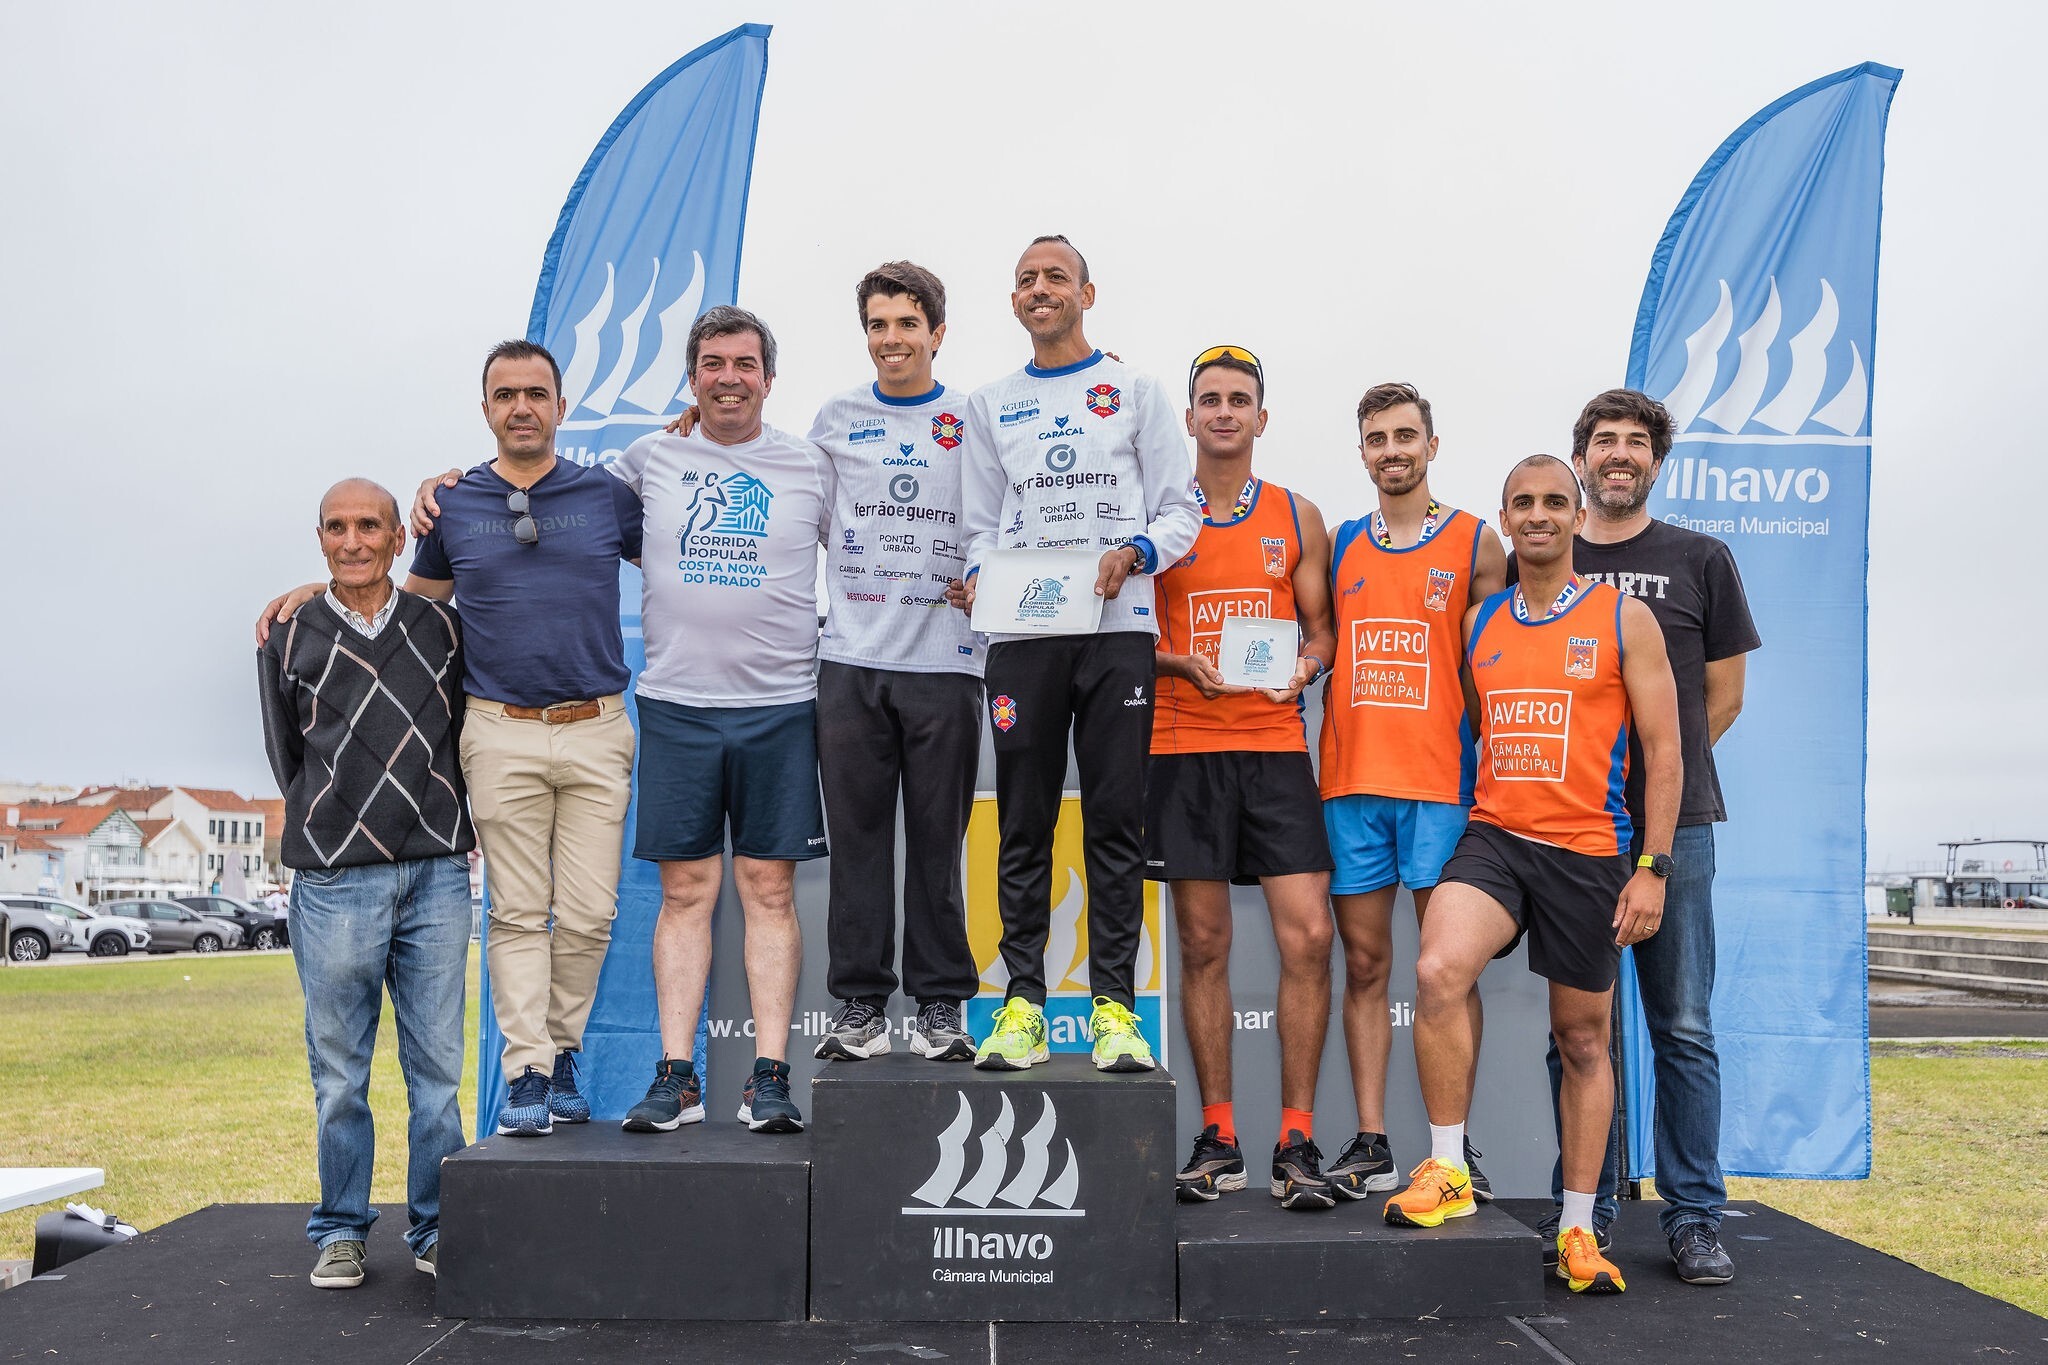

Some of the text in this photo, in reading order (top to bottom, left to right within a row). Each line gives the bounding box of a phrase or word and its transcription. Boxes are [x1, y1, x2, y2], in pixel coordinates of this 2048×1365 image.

[1038, 427, 1085, 440] CARACAL
[882, 458, 930, 468] CARACAL
[1666, 457, 1830, 504] Ilhavo
[1040, 502, 1076, 514] PONTO
[1044, 512, 1086, 523] URBANO
[1740, 517, 1830, 538] Municipal
[690, 535, 758, 549] CORRIDA
[880, 534, 914, 545] PONTO
[1037, 537, 1090, 549] colorcenter
[1262, 538, 1285, 546] CENAP
[688, 548, 758, 562] POPULAR
[882, 544, 922, 554] URBANO
[678, 560, 768, 576] COSTA NOVA
[1430, 568, 1455, 580] CENAP
[684, 573, 761, 588] DO PRADO
[873, 570, 923, 580] colorcenter
[932, 574, 957, 584] ITALB
[846, 592, 886, 603] BESTLOQUE
[1196, 600, 1267, 625] AVEIRO
[1358, 630, 1425, 654] AVEIRO
[1569, 638, 1597, 646] CENAP
[1354, 684, 1422, 700] MUNICIPAL
[1493, 702, 1564, 726] AVEIRO
[1494, 758, 1559, 773] MUNICIPAL
[933, 1226, 1054, 1260] Ilhavo
[932, 1268, 1054, 1285] Câmara Municipal
